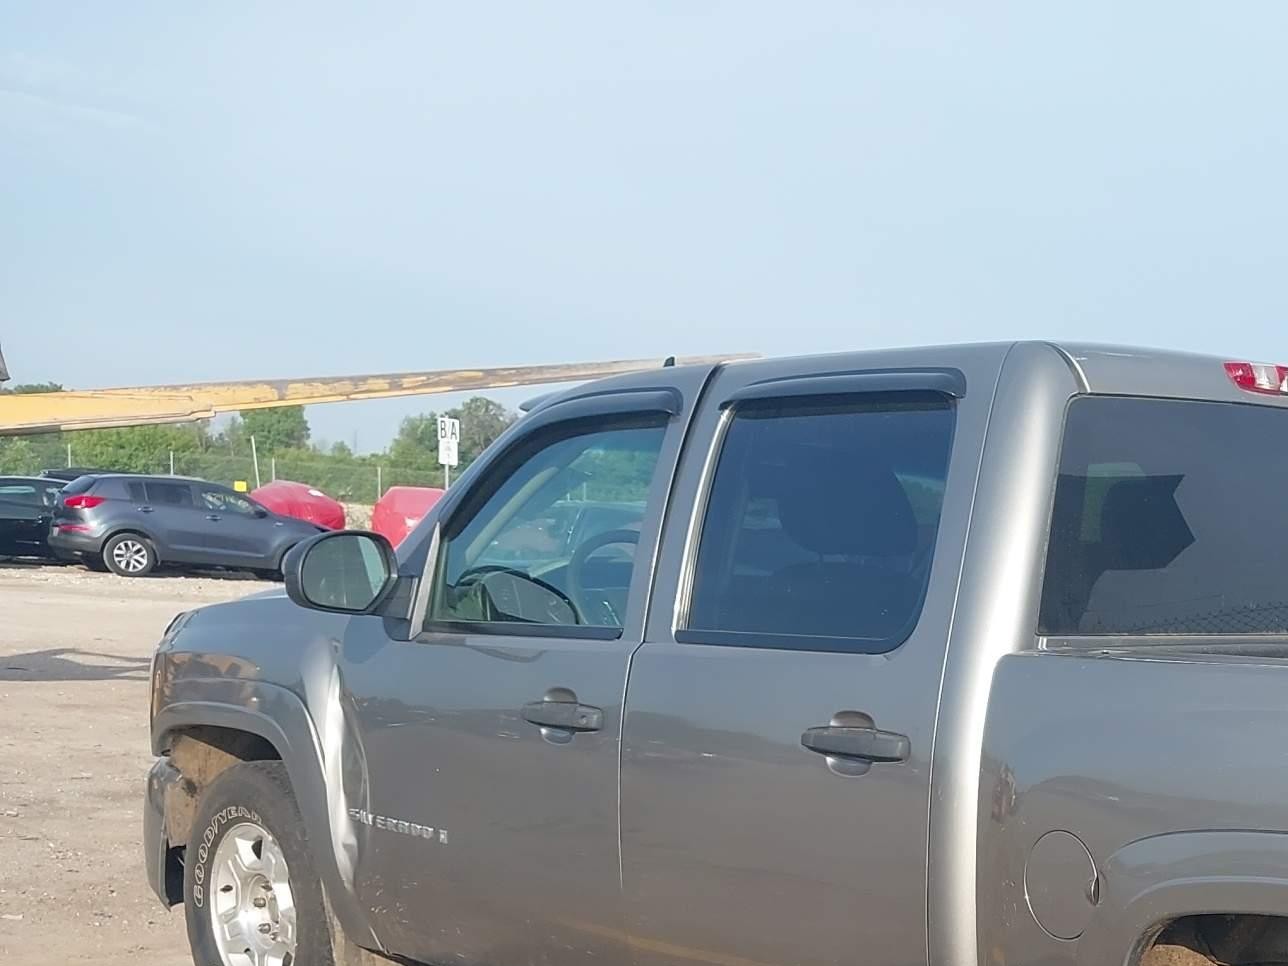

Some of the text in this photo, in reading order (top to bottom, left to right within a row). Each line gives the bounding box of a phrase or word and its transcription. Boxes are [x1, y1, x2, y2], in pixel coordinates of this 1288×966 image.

[440, 420, 458, 440] B A
[193, 805, 263, 908] GOODYEAR
